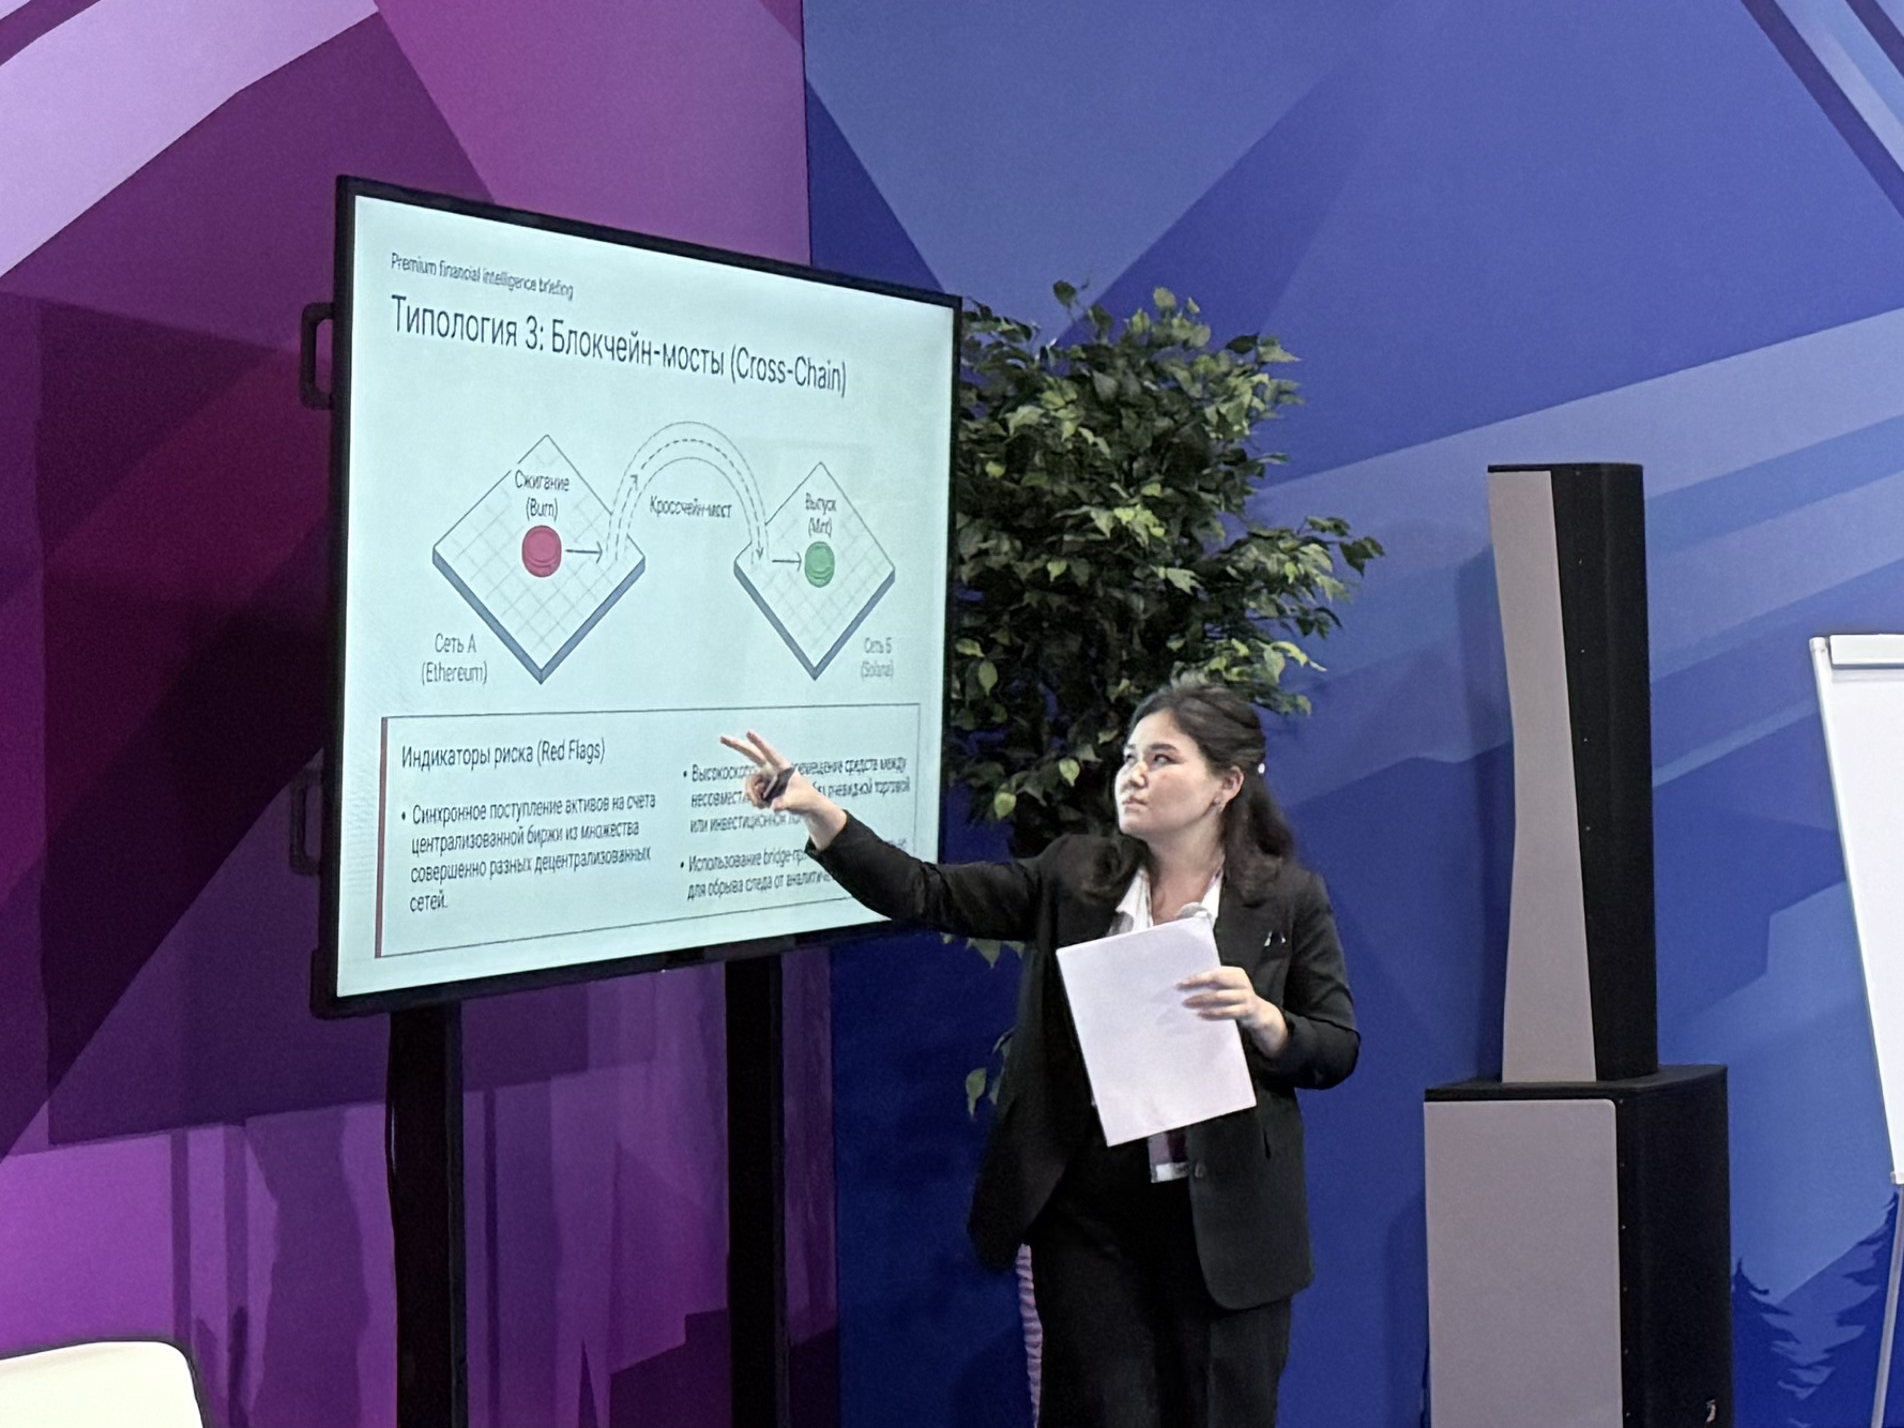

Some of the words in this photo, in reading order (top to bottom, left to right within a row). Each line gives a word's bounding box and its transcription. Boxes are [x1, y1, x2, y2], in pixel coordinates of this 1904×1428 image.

[391, 252, 437, 276] Premium
[391, 294, 517, 347] Типология
[525, 315, 545, 351] 3:
[552, 317, 725, 376] Блокчейн-мосты
[730, 343, 847, 398] (Cross-Chain)
[434, 633, 464, 653] Сеть
[421, 660, 488, 685] (Ethereum)
[402, 745, 491, 771] Индикаторы
[494, 744, 534, 769] риска
[537, 739, 565, 767] (Red
[568, 736, 606, 765] Flags)
[412, 804, 488, 825] Синхронное
[489, 798, 563, 822] поступление
[565, 795, 609, 814] активов
[611, 795, 625, 811] на
[626, 792, 656, 810] счета
[411, 826, 525, 857] централизованной
[526, 824, 563, 848] биржи
[565, 826, 578, 841] из
[411, 860, 487, 885] совершенно
[489, 856, 533, 880] разных
[534, 846, 652, 874] децентрализованных
[689, 851, 763, 872] Использование
[409, 889, 449, 913] сетей.
